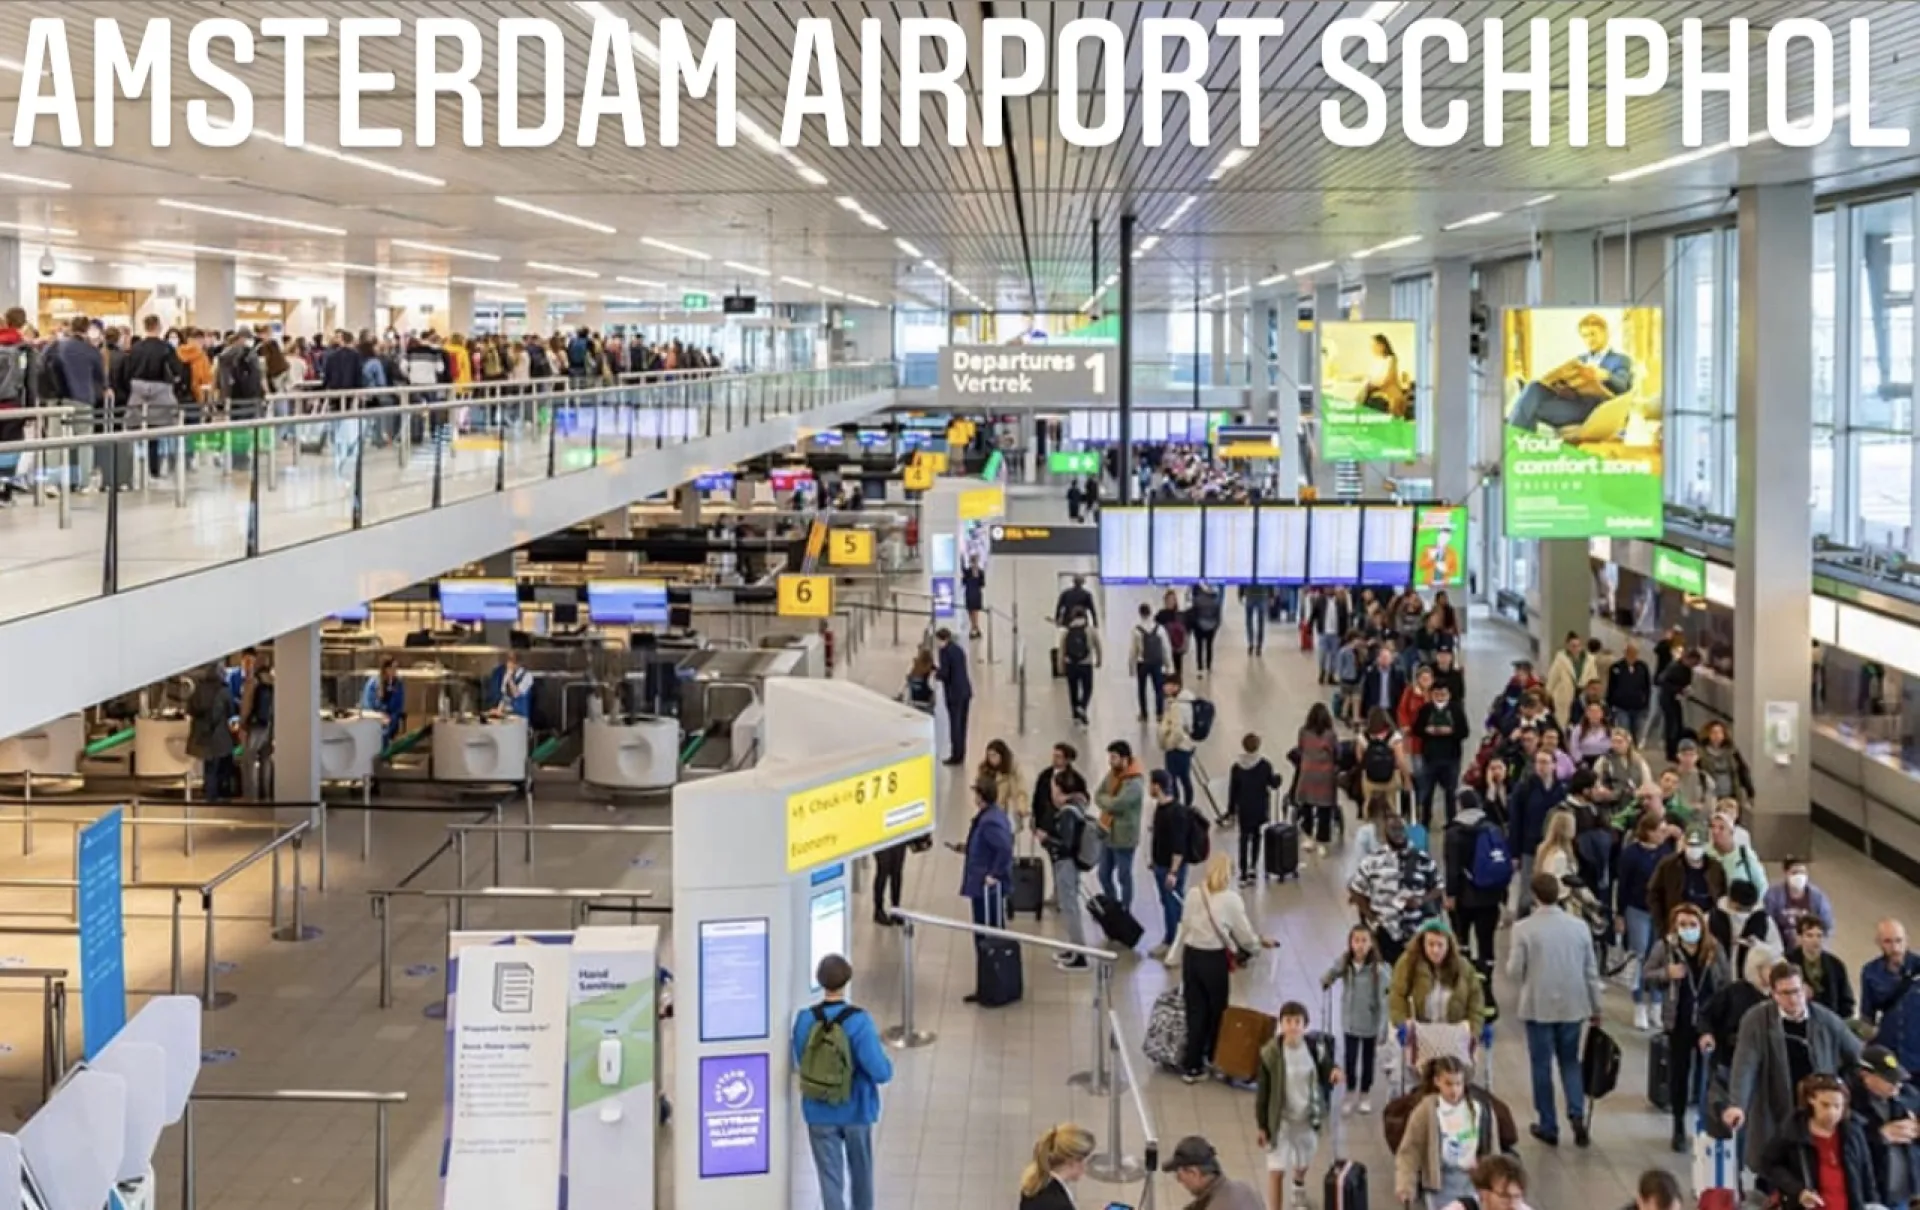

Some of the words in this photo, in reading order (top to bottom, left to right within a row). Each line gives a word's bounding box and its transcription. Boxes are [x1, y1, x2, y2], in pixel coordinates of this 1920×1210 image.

[952, 351, 1075, 374] Departures
[1084, 352, 1105, 394] 1
[952, 373, 1033, 393] Vertrek
[1514, 434, 1563, 453] Your
[1514, 454, 1598, 474] comfort
[1601, 459, 1653, 474] zone
[844, 533, 858, 555] 5
[796, 579, 813, 604] 6
[855, 781, 865, 804] 6
[872, 775, 881, 799] 7
[888, 771, 898, 794] 8
[791, 833, 837, 857] Economy
[578, 967, 610, 980] Hand
